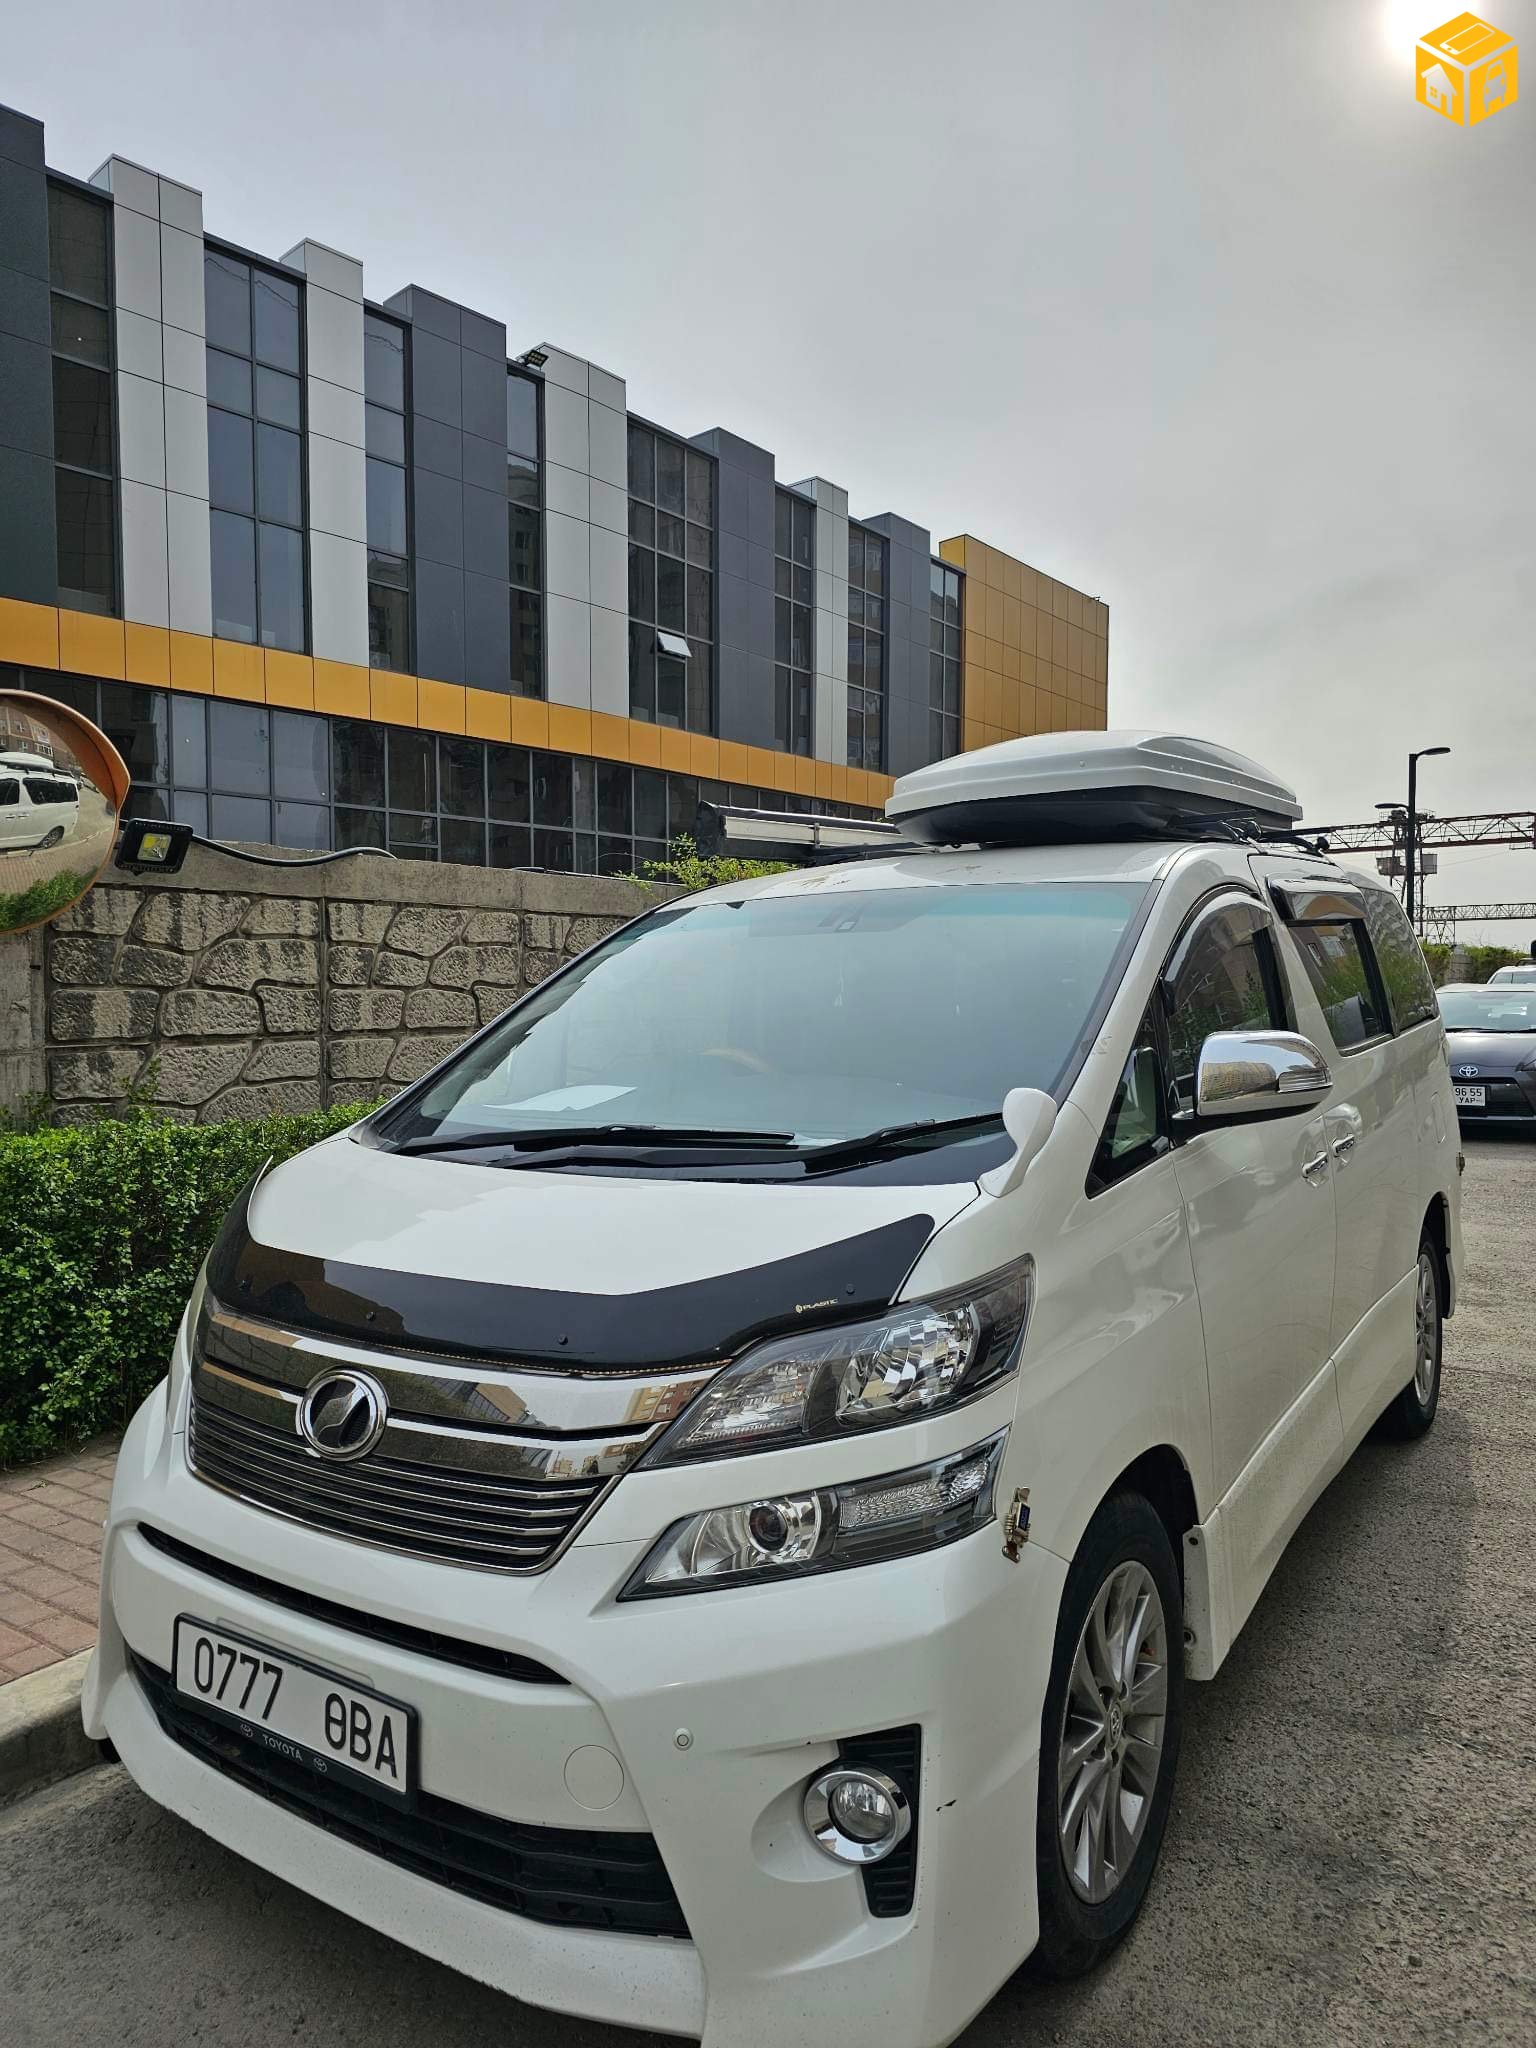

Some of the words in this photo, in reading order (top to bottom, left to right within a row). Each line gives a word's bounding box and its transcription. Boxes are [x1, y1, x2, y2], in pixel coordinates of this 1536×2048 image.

[1455, 1087, 1467, 1097] 96
[1470, 1087, 1482, 1097] 55
[194, 1637, 283, 1720] 0777
[262, 1734, 303, 1761] TOYOTA
